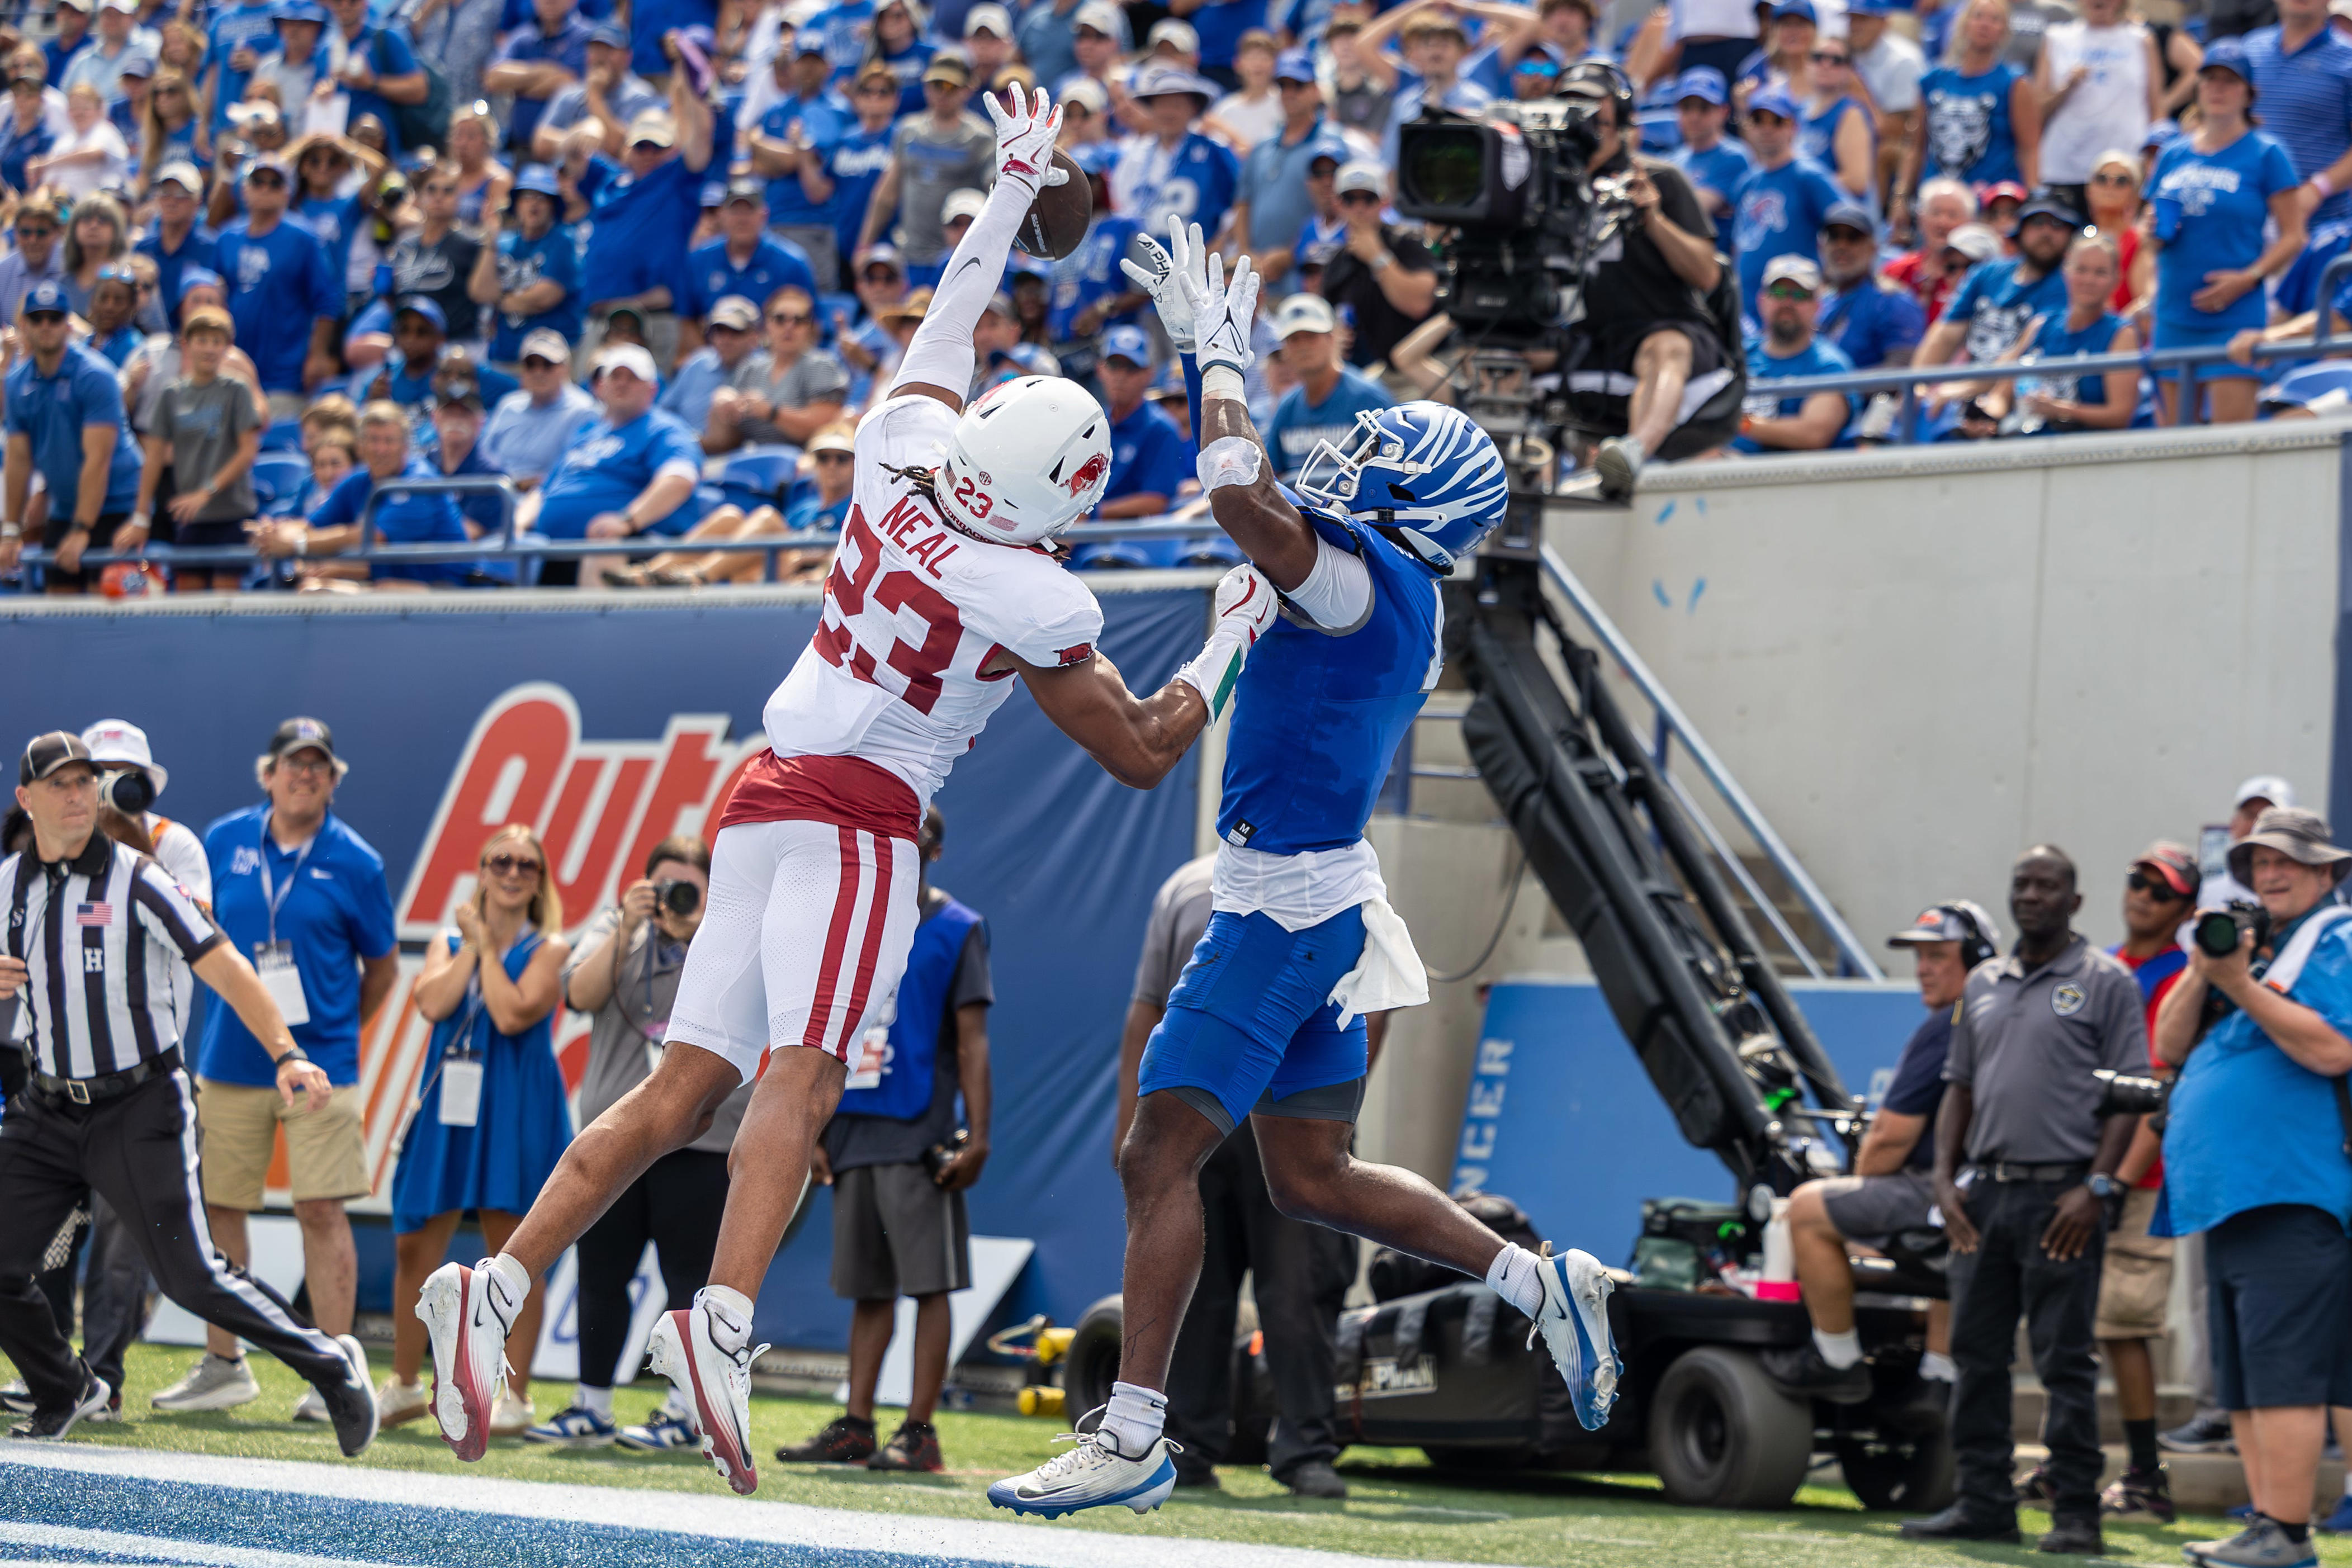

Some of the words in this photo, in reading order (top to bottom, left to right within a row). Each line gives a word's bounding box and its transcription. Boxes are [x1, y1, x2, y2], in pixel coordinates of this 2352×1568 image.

[1138, 240, 1171, 286] ALPHA
[954, 477, 993, 518] 23
[979, 471, 992, 485] SEC
[878, 496, 960, 580] NEAL
[813, 504, 965, 717] 23
[1239, 823, 1250, 834] M
[84, 948, 103, 973] H
